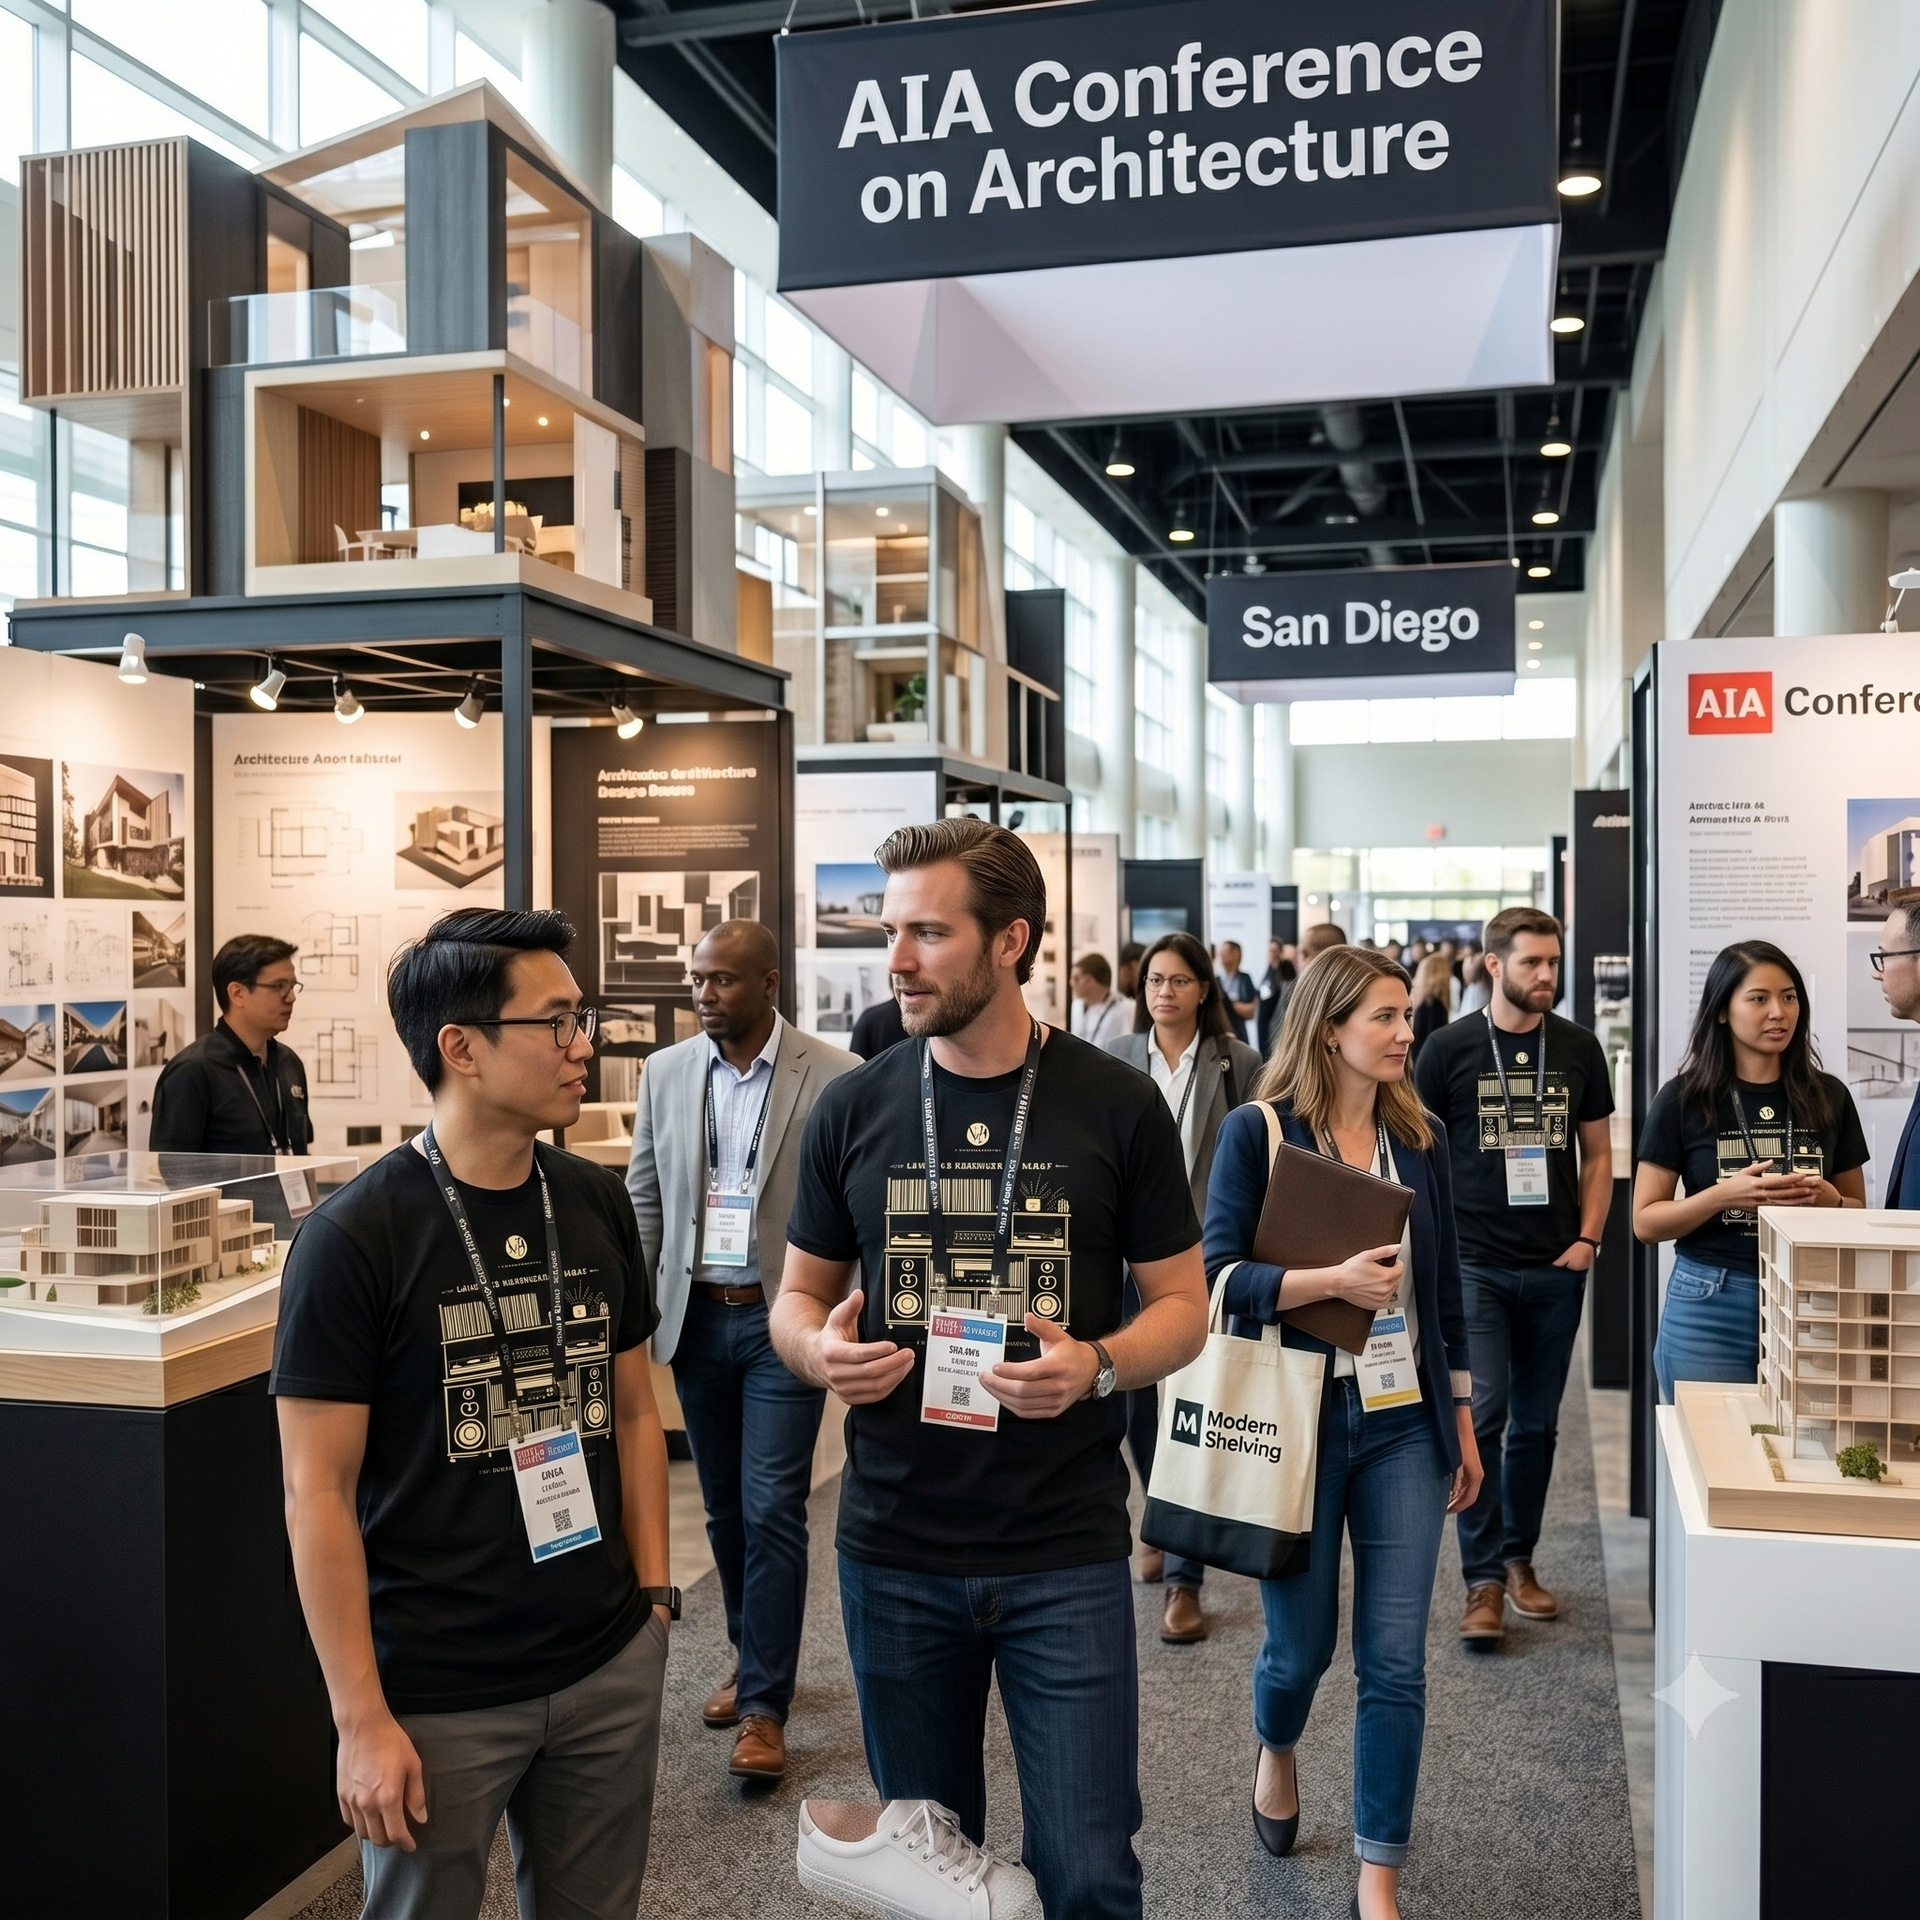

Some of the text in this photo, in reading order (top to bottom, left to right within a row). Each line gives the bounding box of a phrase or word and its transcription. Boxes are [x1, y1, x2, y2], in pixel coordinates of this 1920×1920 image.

[838, 29, 1484, 149] AIA Conference
[860, 119, 1450, 224] on Architecture
[1242, 599, 1480, 652] San Diego
[1694, 687, 1767, 719] AIA
[1175, 1410, 1197, 1435] M
[1207, 1410, 1278, 1436] Modern
[1205, 1430, 1282, 1464] Shelving
